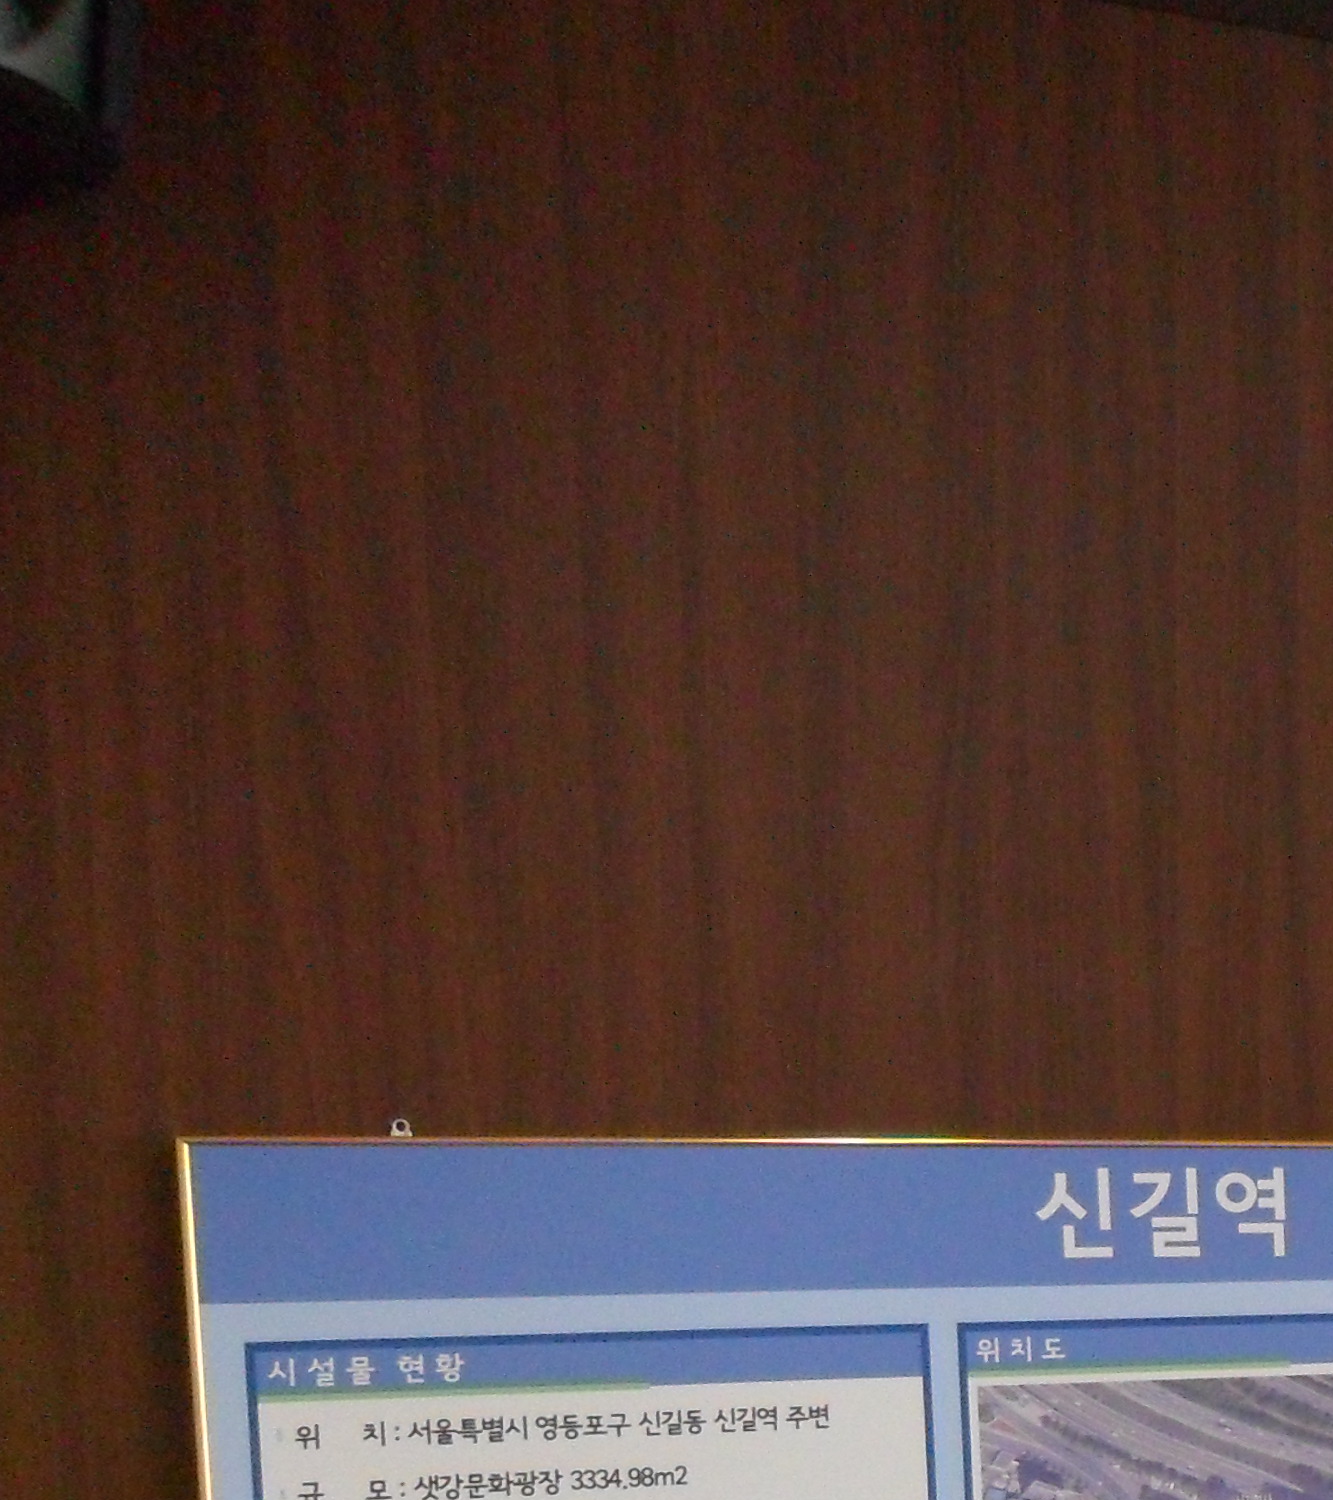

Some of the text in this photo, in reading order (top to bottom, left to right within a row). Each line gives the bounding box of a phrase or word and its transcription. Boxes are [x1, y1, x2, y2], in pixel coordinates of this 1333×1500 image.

[1035, 1166, 1287, 1259] 신길역
[976, 1335, 1066, 1363] 위치도
[267, 1352, 465, 1387] 시설물 현황
[407, 1415, 528, 1446] 서울특별시
[534, 1413, 632, 1441] 영등포구
[638, 1409, 707, 1437] 신길동
[714, 1405, 778, 1433] 신길역
[785, 1403, 830, 1430] 주변
[570, 1465, 688, 1491] 3334.98m2
